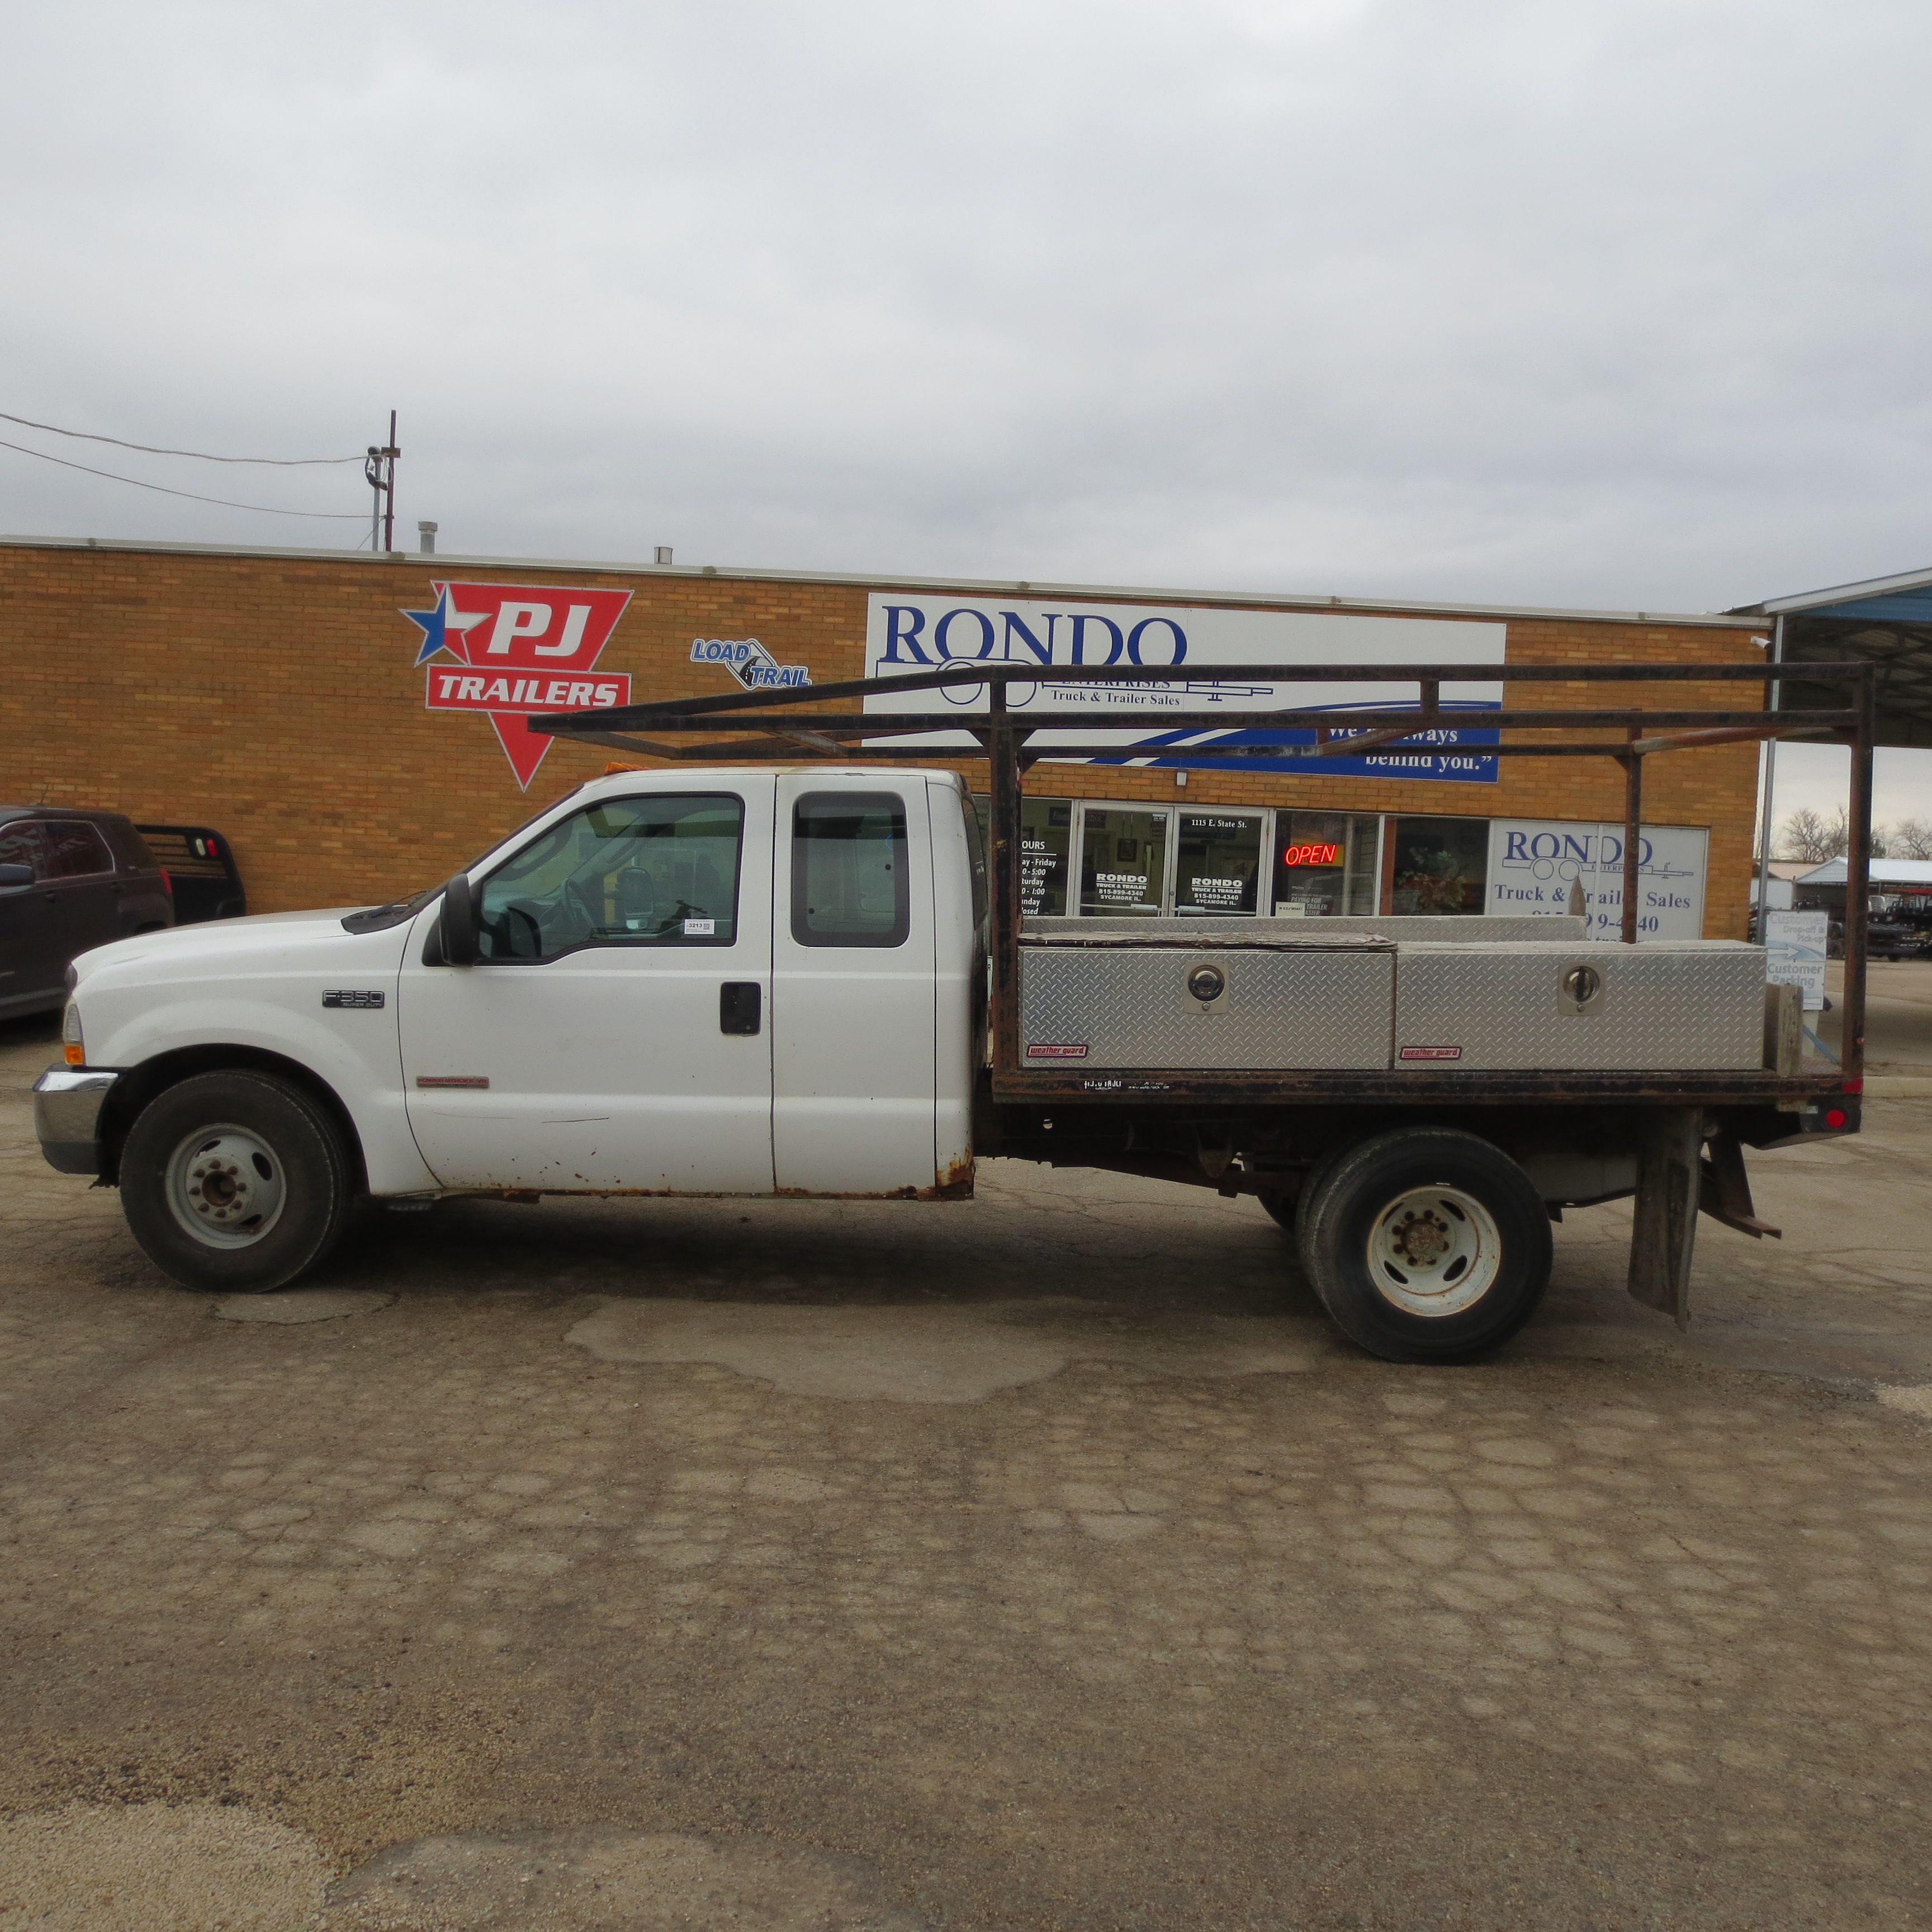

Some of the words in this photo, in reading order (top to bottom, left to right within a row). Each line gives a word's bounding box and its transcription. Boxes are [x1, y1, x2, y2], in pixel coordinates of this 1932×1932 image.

[486, 601, 592, 657] PJ
[879, 606, 1187, 665] RONDO
[694, 642, 750, 661] LOAD
[750, 667, 809, 686] TRAIL
[438, 675, 619, 707] TRAILERS
[1051, 690, 1086, 701] Truck
[1091, 692, 1101, 702] &
[1105, 692, 1147, 704] Trailer
[1150, 694, 1180, 705] Sales
[1022, 840, 1045, 850] OURS
[1285, 844, 1337, 865] OPEN
[1035, 859, 1057, 868] Friday
[1022, 878, 1044, 887] turday
[1096, 873, 1148, 883] RONDO
[1191, 877, 1243, 887] RONDO
[1494, 884, 1544, 901] Truck
[1552, 887, 1564, 902] &
[1646, 891, 1690, 908] Sales
[1770, 913, 1825, 924] Customer
[1783, 925, 1817, 935] Drop-off
[1797, 934, 1824, 944] Pick-up
[1767, 963, 1823, 974] Customer
[1773, 975, 1815, 989] Parking
[1063, 1046, 1084, 1055] guard
